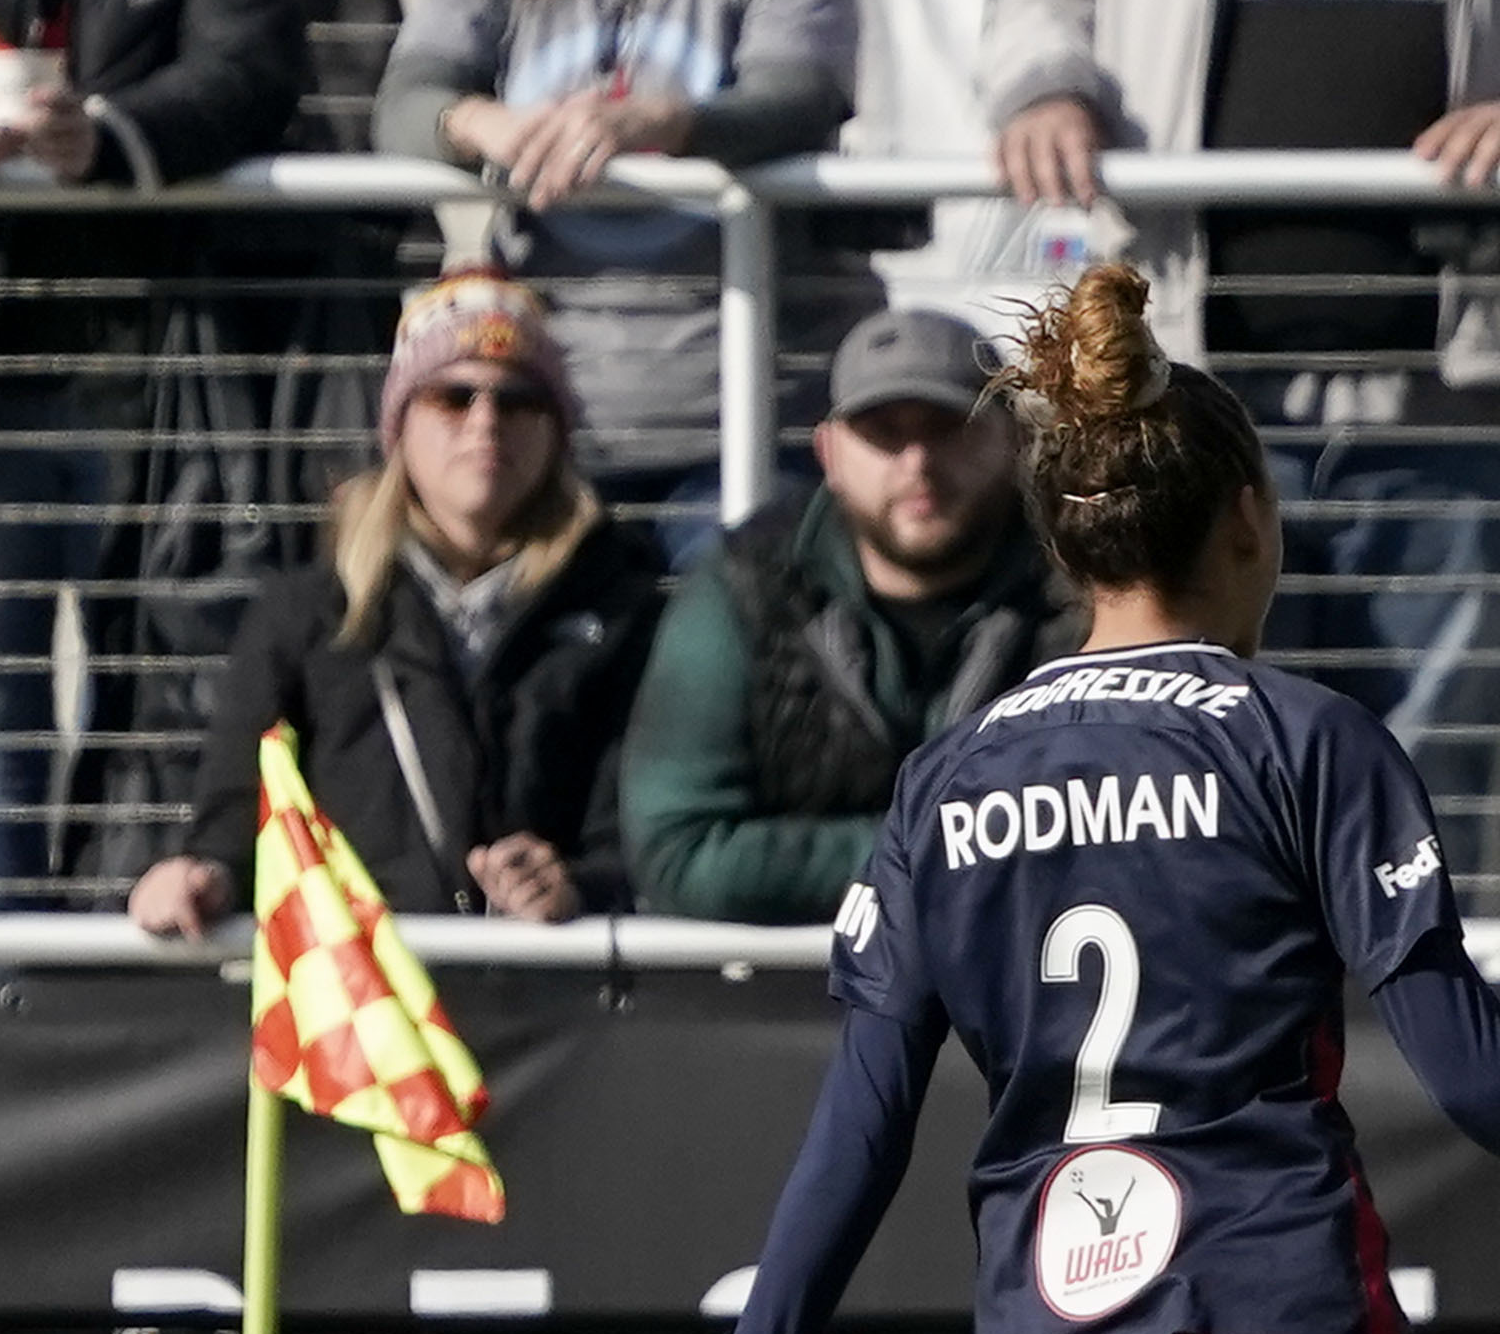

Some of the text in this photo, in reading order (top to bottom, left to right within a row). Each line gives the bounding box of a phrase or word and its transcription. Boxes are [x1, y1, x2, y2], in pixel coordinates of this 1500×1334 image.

[939, 771, 1219, 870] RODMAN
[1373, 833, 1442, 900] Fed
[1041, 903, 1163, 1145] 2
[1064, 1229, 1148, 1286] WAGS
